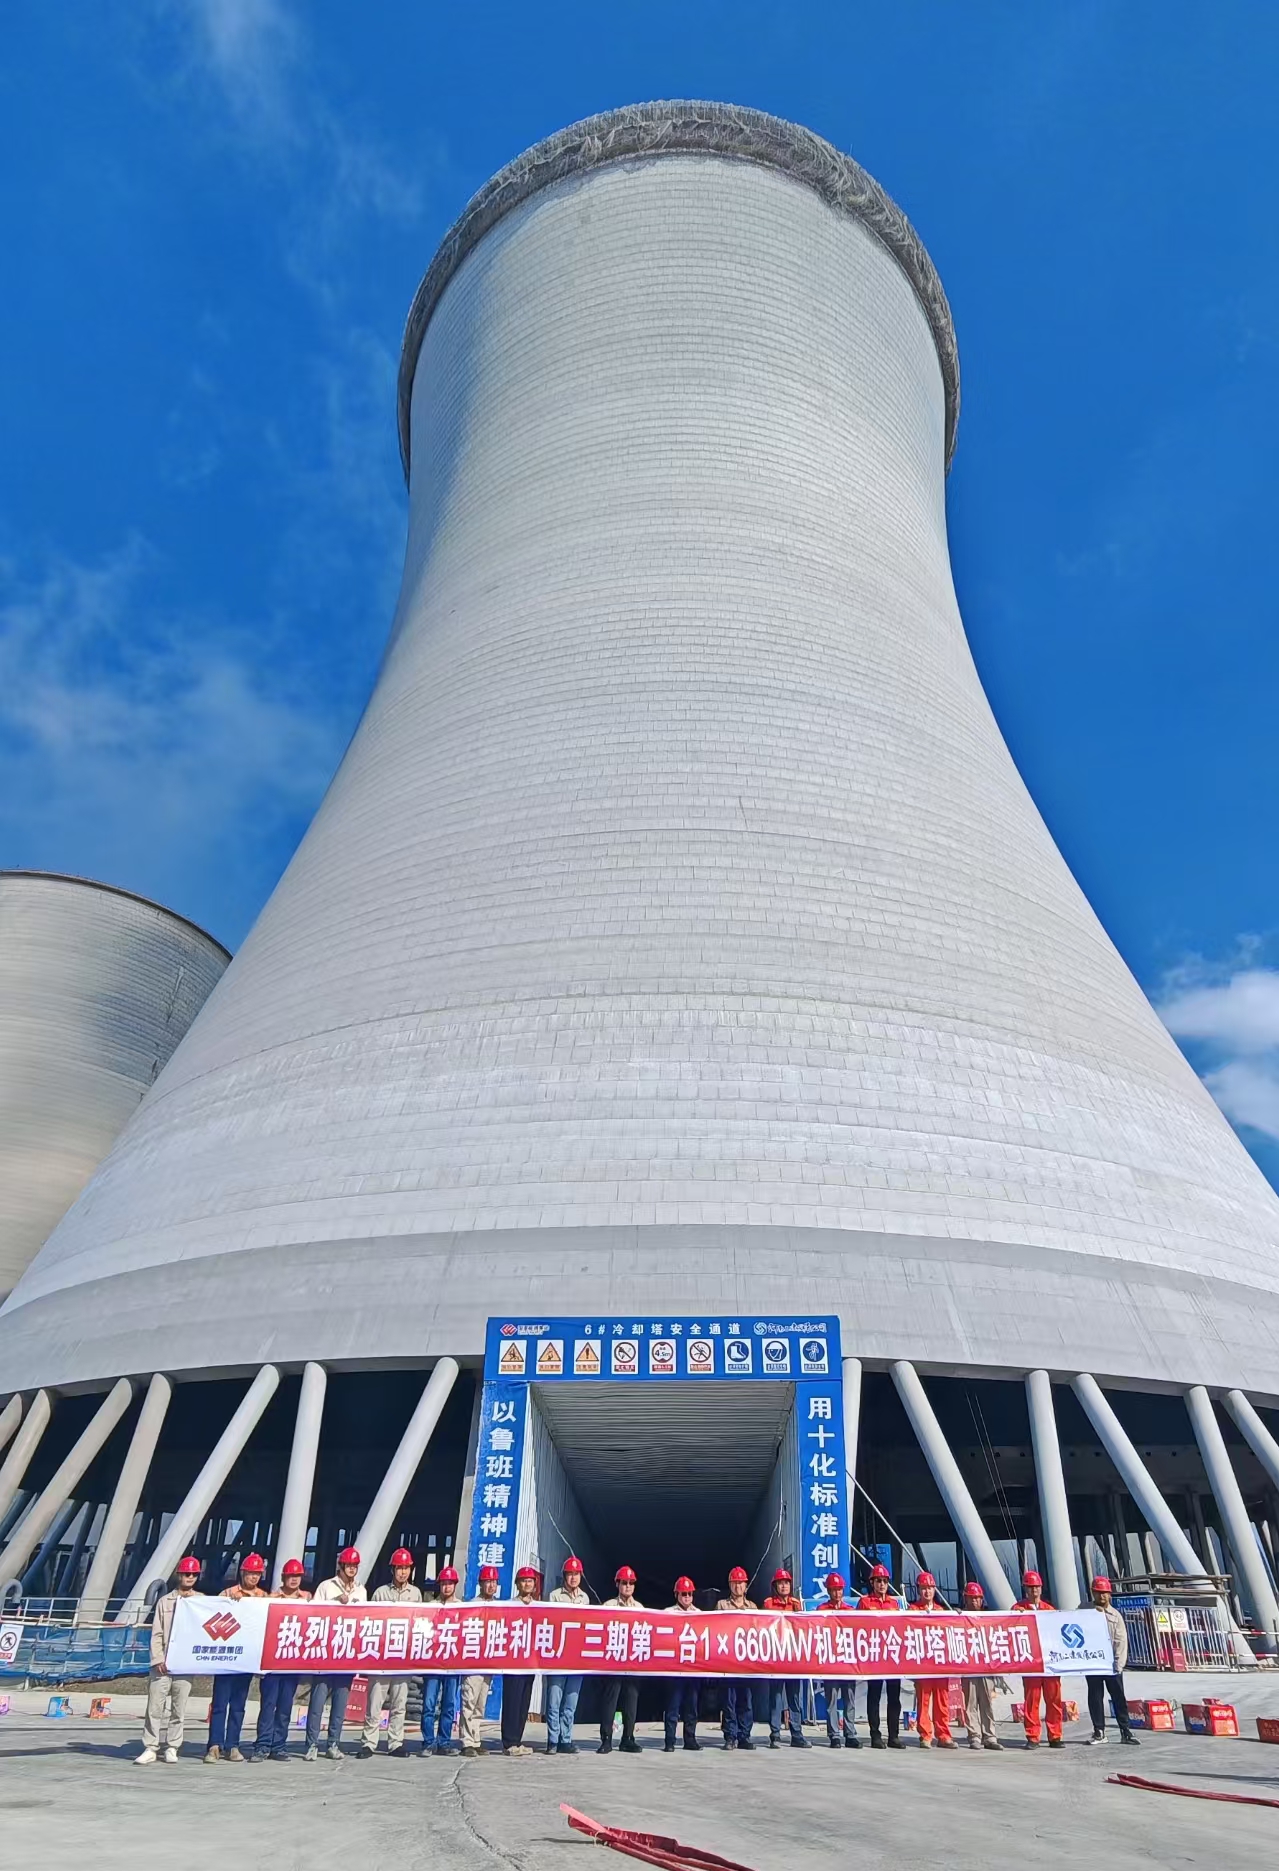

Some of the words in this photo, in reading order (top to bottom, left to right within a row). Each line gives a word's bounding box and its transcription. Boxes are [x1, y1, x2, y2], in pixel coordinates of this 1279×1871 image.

[584, 1323, 740, 1335] 6#冷却塔安全通道
[476, 1401, 516, 1599] 以鲁班精神建
[192, 1645, 243, 1654] 国家能源集团
